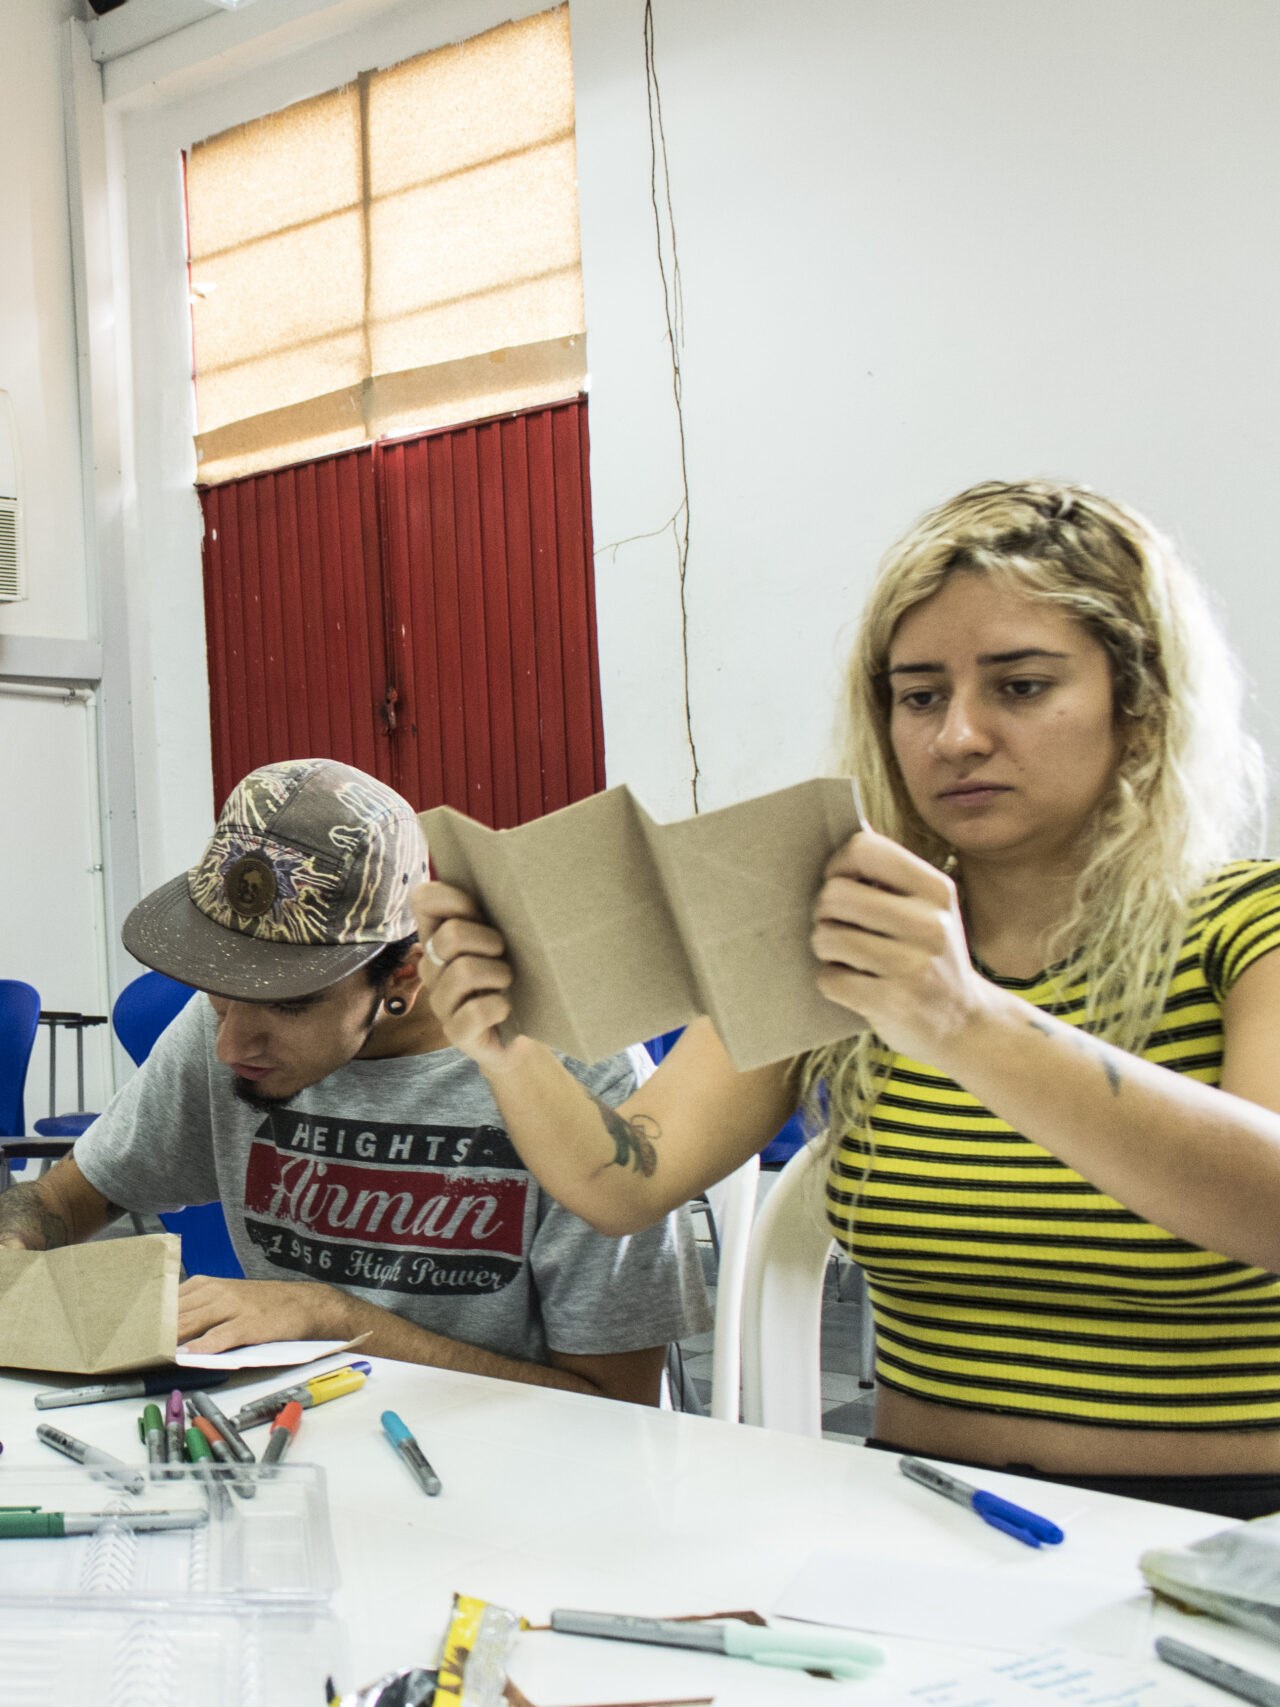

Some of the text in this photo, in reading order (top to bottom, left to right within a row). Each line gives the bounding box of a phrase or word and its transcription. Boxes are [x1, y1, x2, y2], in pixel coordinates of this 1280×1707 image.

[291, 1123, 473, 1164] HEIGHTS
[270, 1156, 505, 1240] Airman
[345, 1250, 402, 1288] High
[408, 1257, 508, 1290] Power
